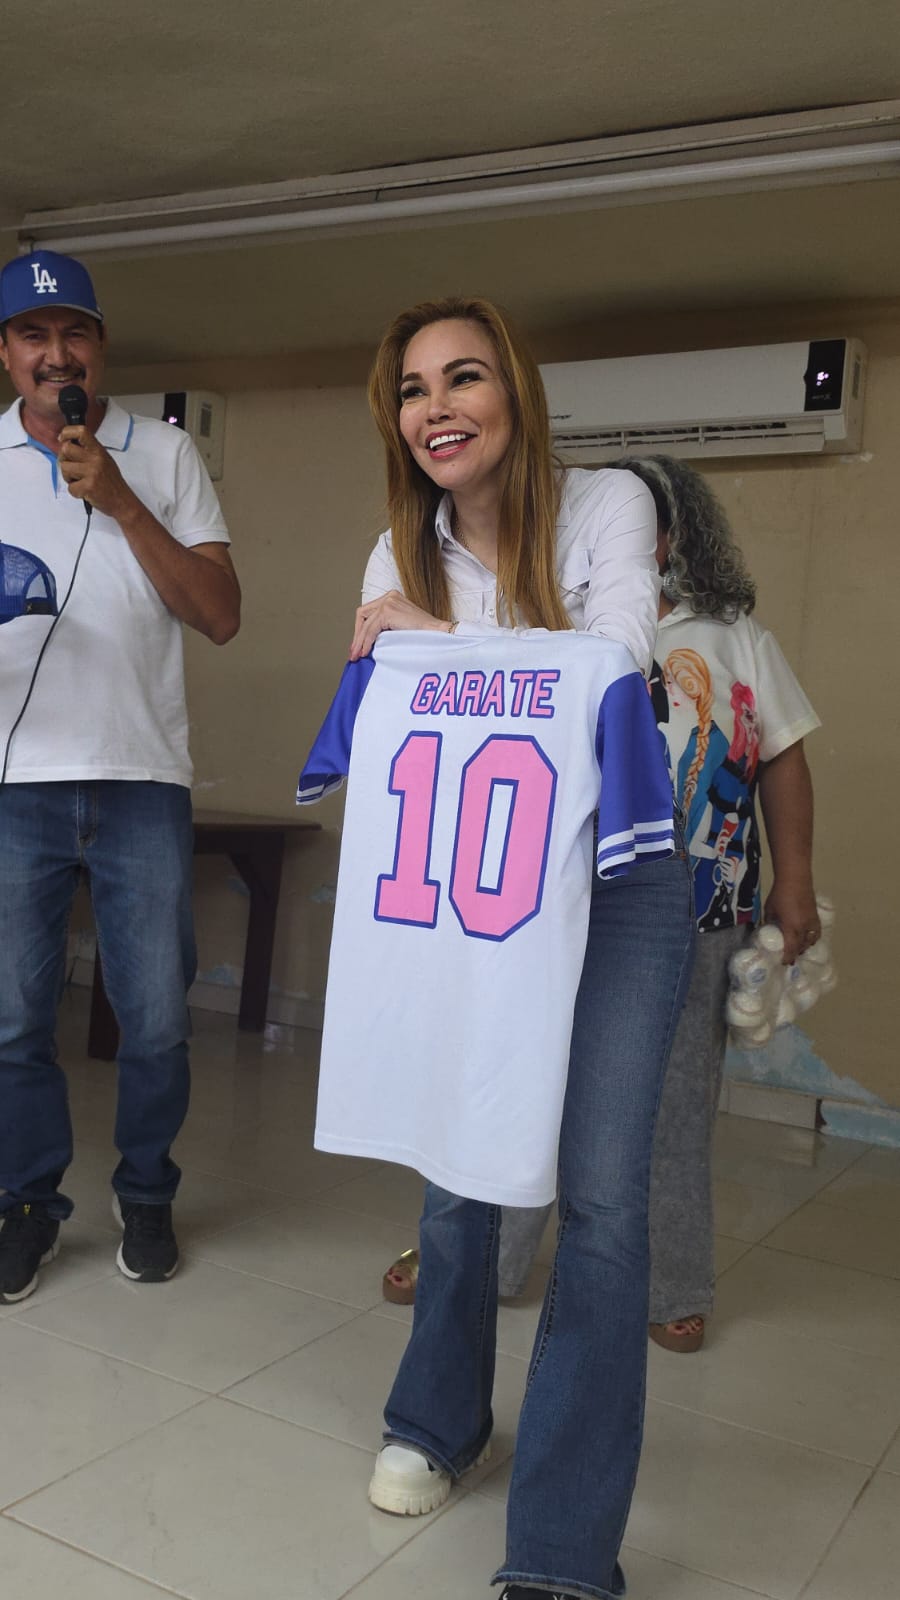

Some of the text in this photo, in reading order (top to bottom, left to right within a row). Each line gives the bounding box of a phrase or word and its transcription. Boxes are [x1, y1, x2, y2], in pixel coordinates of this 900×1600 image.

[31, 263, 58, 293] LA
[411, 669, 561, 718] GARATE
[374, 730, 558, 942] 10
